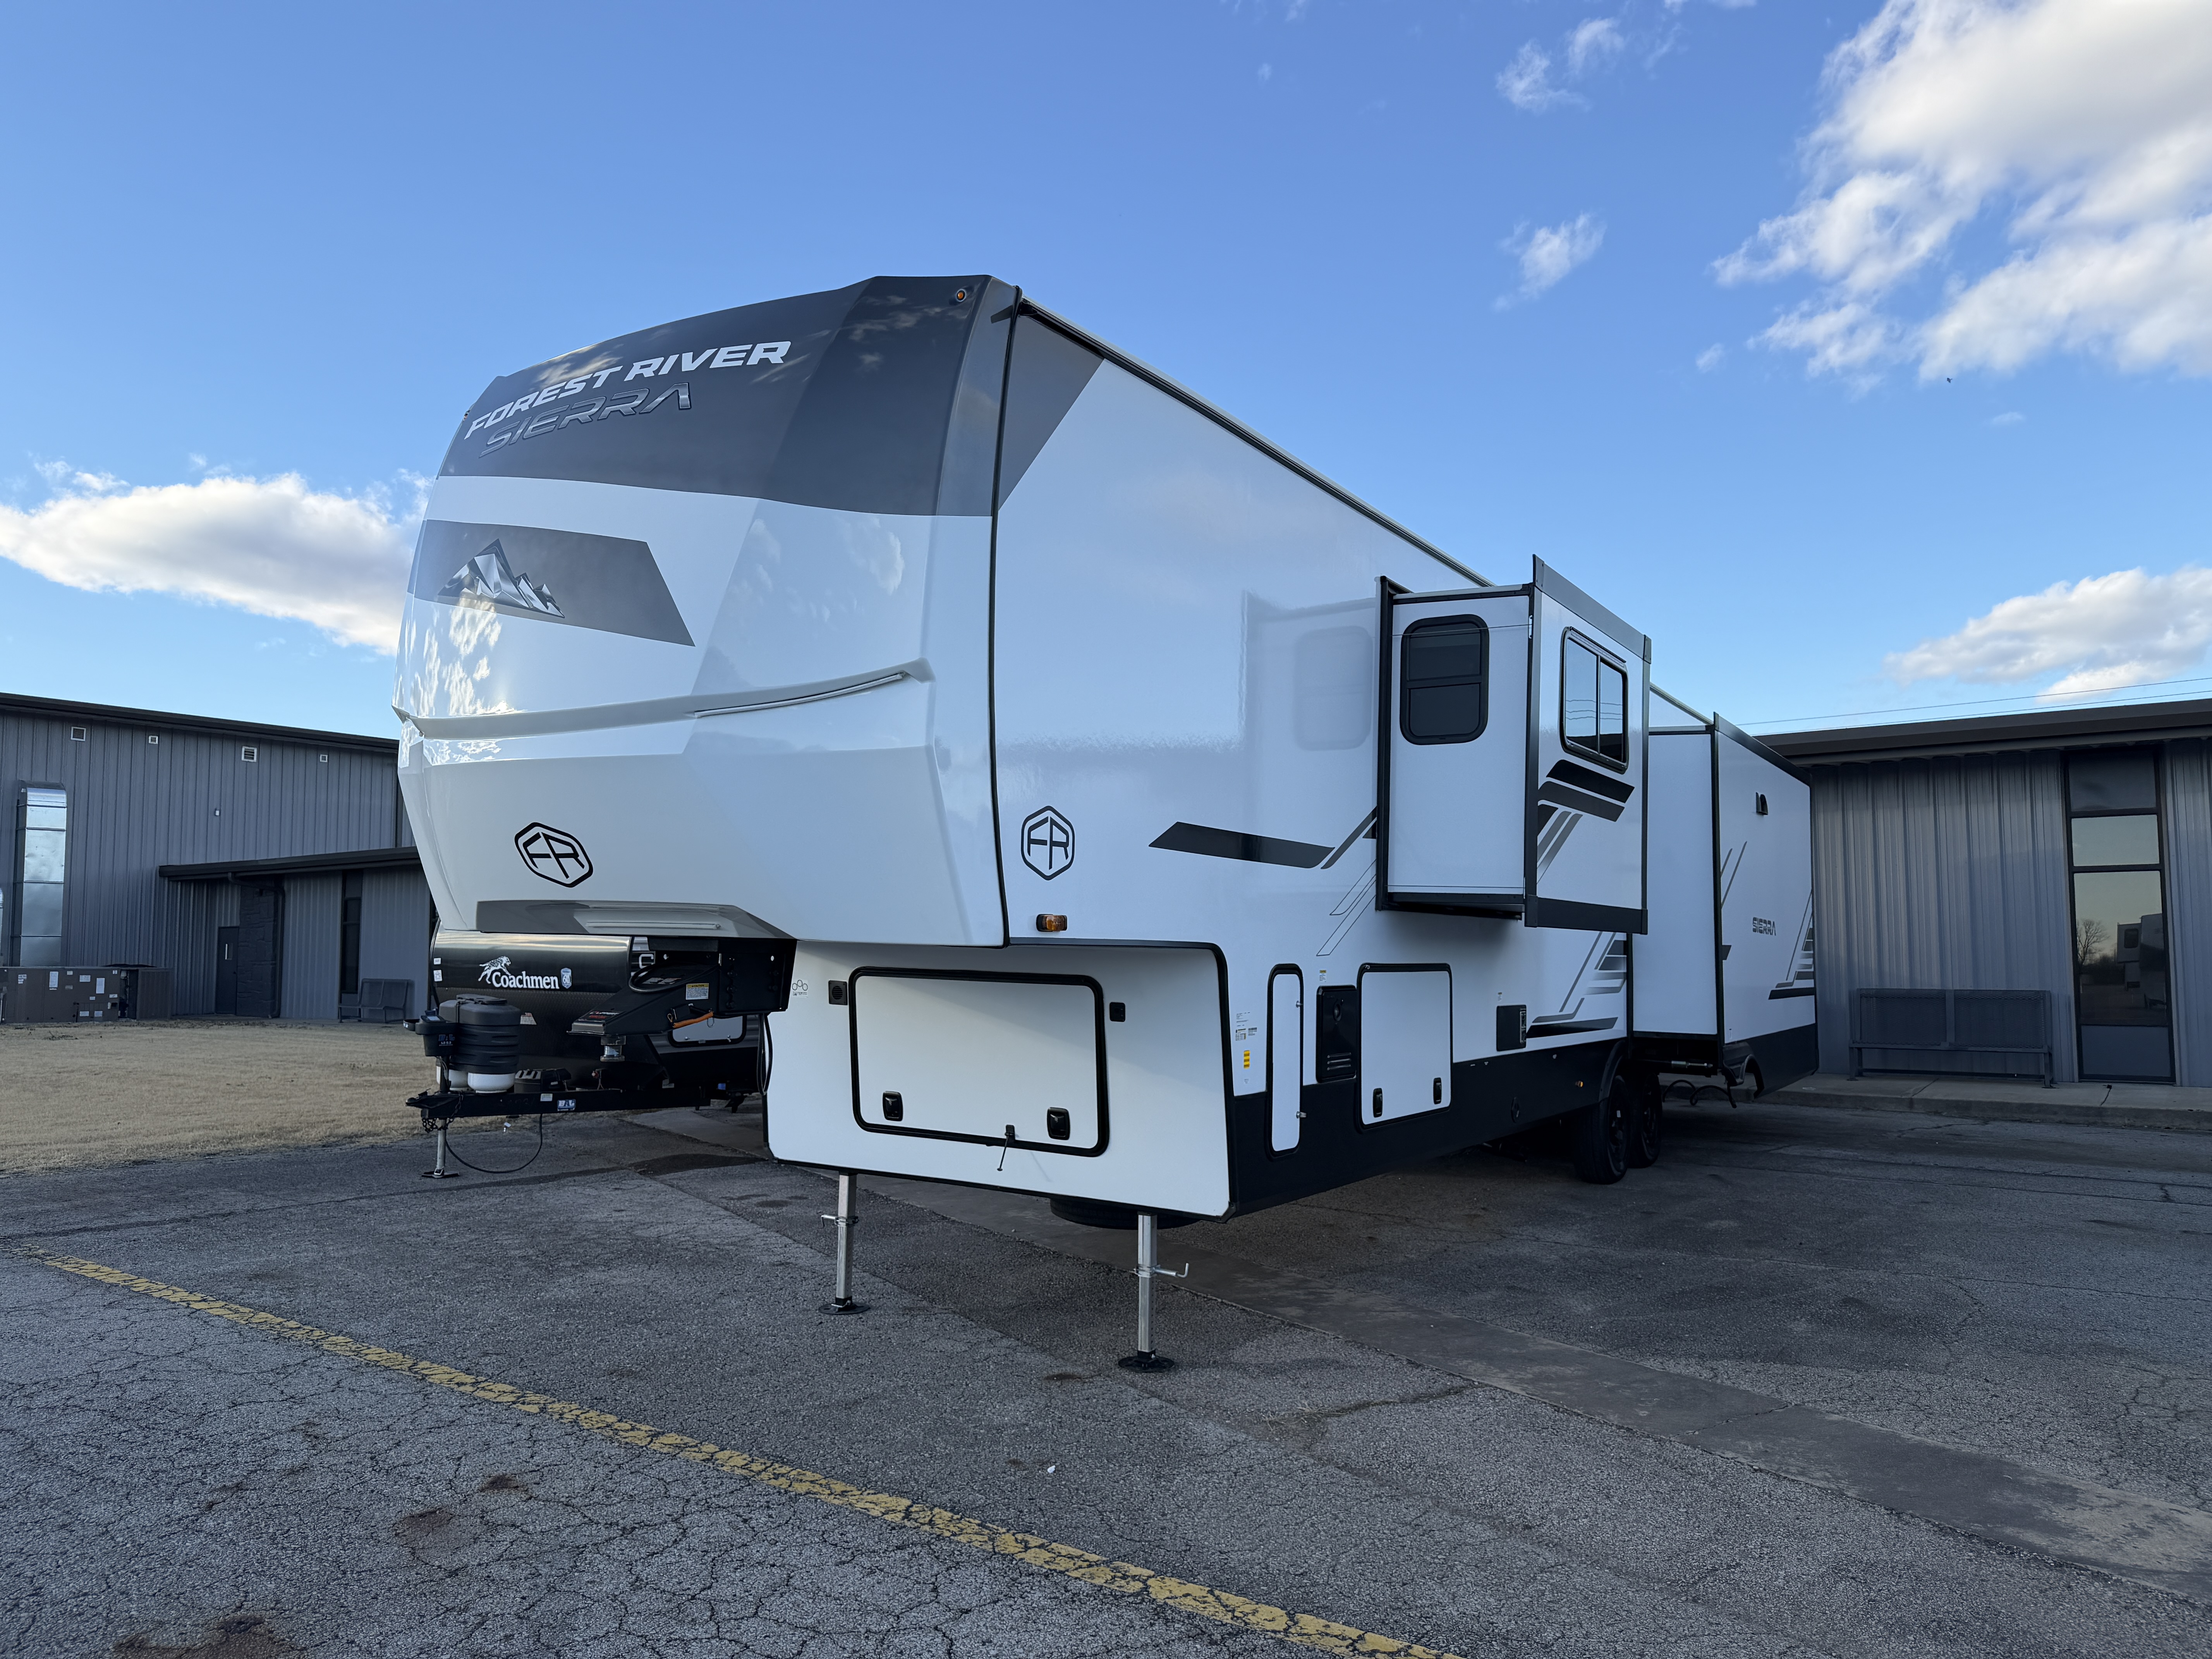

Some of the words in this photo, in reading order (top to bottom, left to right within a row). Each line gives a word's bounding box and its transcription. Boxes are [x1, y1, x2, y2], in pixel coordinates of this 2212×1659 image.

[464, 366, 623, 440] FOREST
[624, 341, 791, 381] RIVER
[479, 382, 691, 458] SIERRA
[1752, 917, 1776, 936] SIERRA
[492, 970, 560, 989] Coachmen
